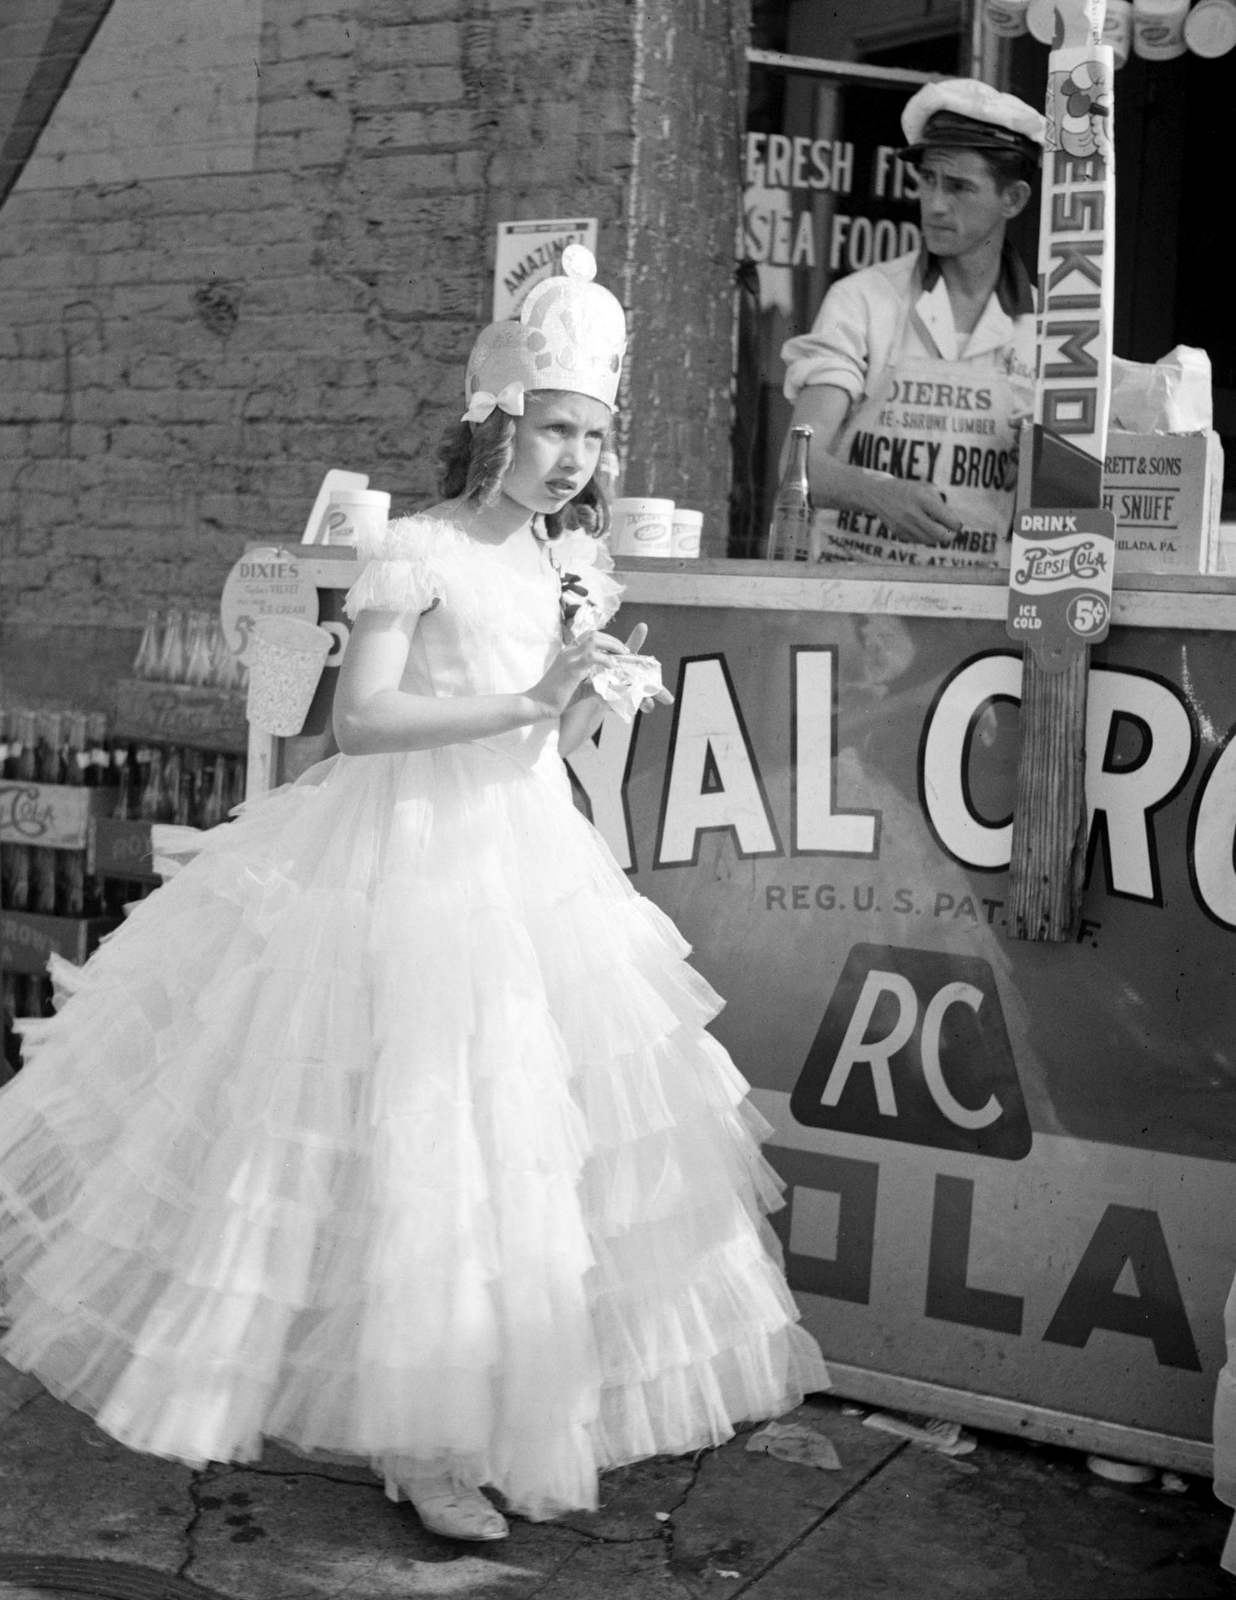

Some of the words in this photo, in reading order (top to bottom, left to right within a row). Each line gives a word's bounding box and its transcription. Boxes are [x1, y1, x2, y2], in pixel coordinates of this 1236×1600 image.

[745, 131, 854, 193] FRESH
[744, 205, 816, 268] SEA
[829, 214, 922, 271] FOOD
[1042, 150, 1107, 435] ESKIMO
[848, 430, 942, 484] NICKEY
[1137, 456, 1148, 475] &
[1148, 456, 1182, 477] SONS
[1020, 514, 1078, 532] DRINK
[1119, 494, 1175, 521] SNUFF
[239, 562, 300, 580] DIXIES
[1013, 617, 1043, 630] COLD
[1018, 604, 1037, 617] ICE
[1073, 599, 1104, 632] 5¢
[765, 885, 845, 912] REG.
[933, 892, 1008, 927] PAT.
[819, 968, 1004, 1129] RC
